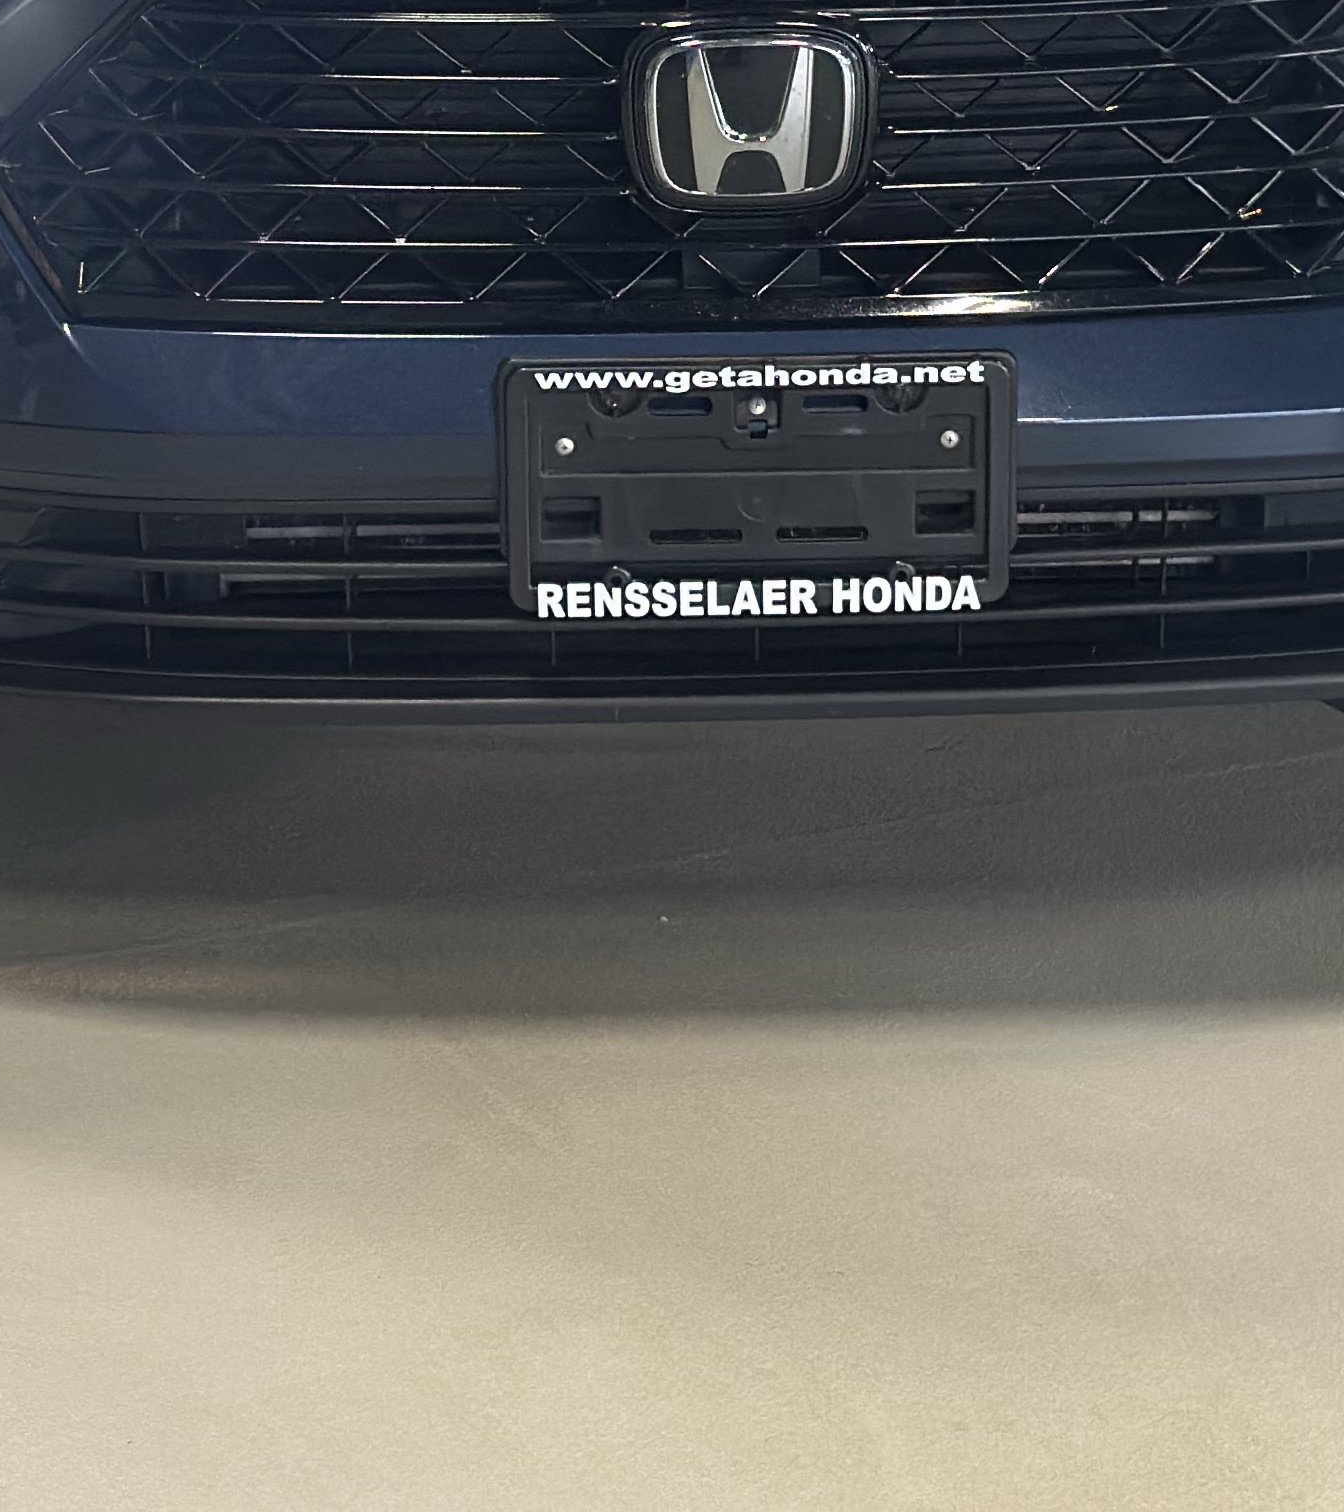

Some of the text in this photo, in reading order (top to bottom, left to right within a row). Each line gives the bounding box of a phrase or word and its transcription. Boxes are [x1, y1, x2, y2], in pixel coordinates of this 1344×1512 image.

[534, 360, 986, 393] www.getahonda.net
[536, 574, 982, 619] RENSSELAER HONDA
